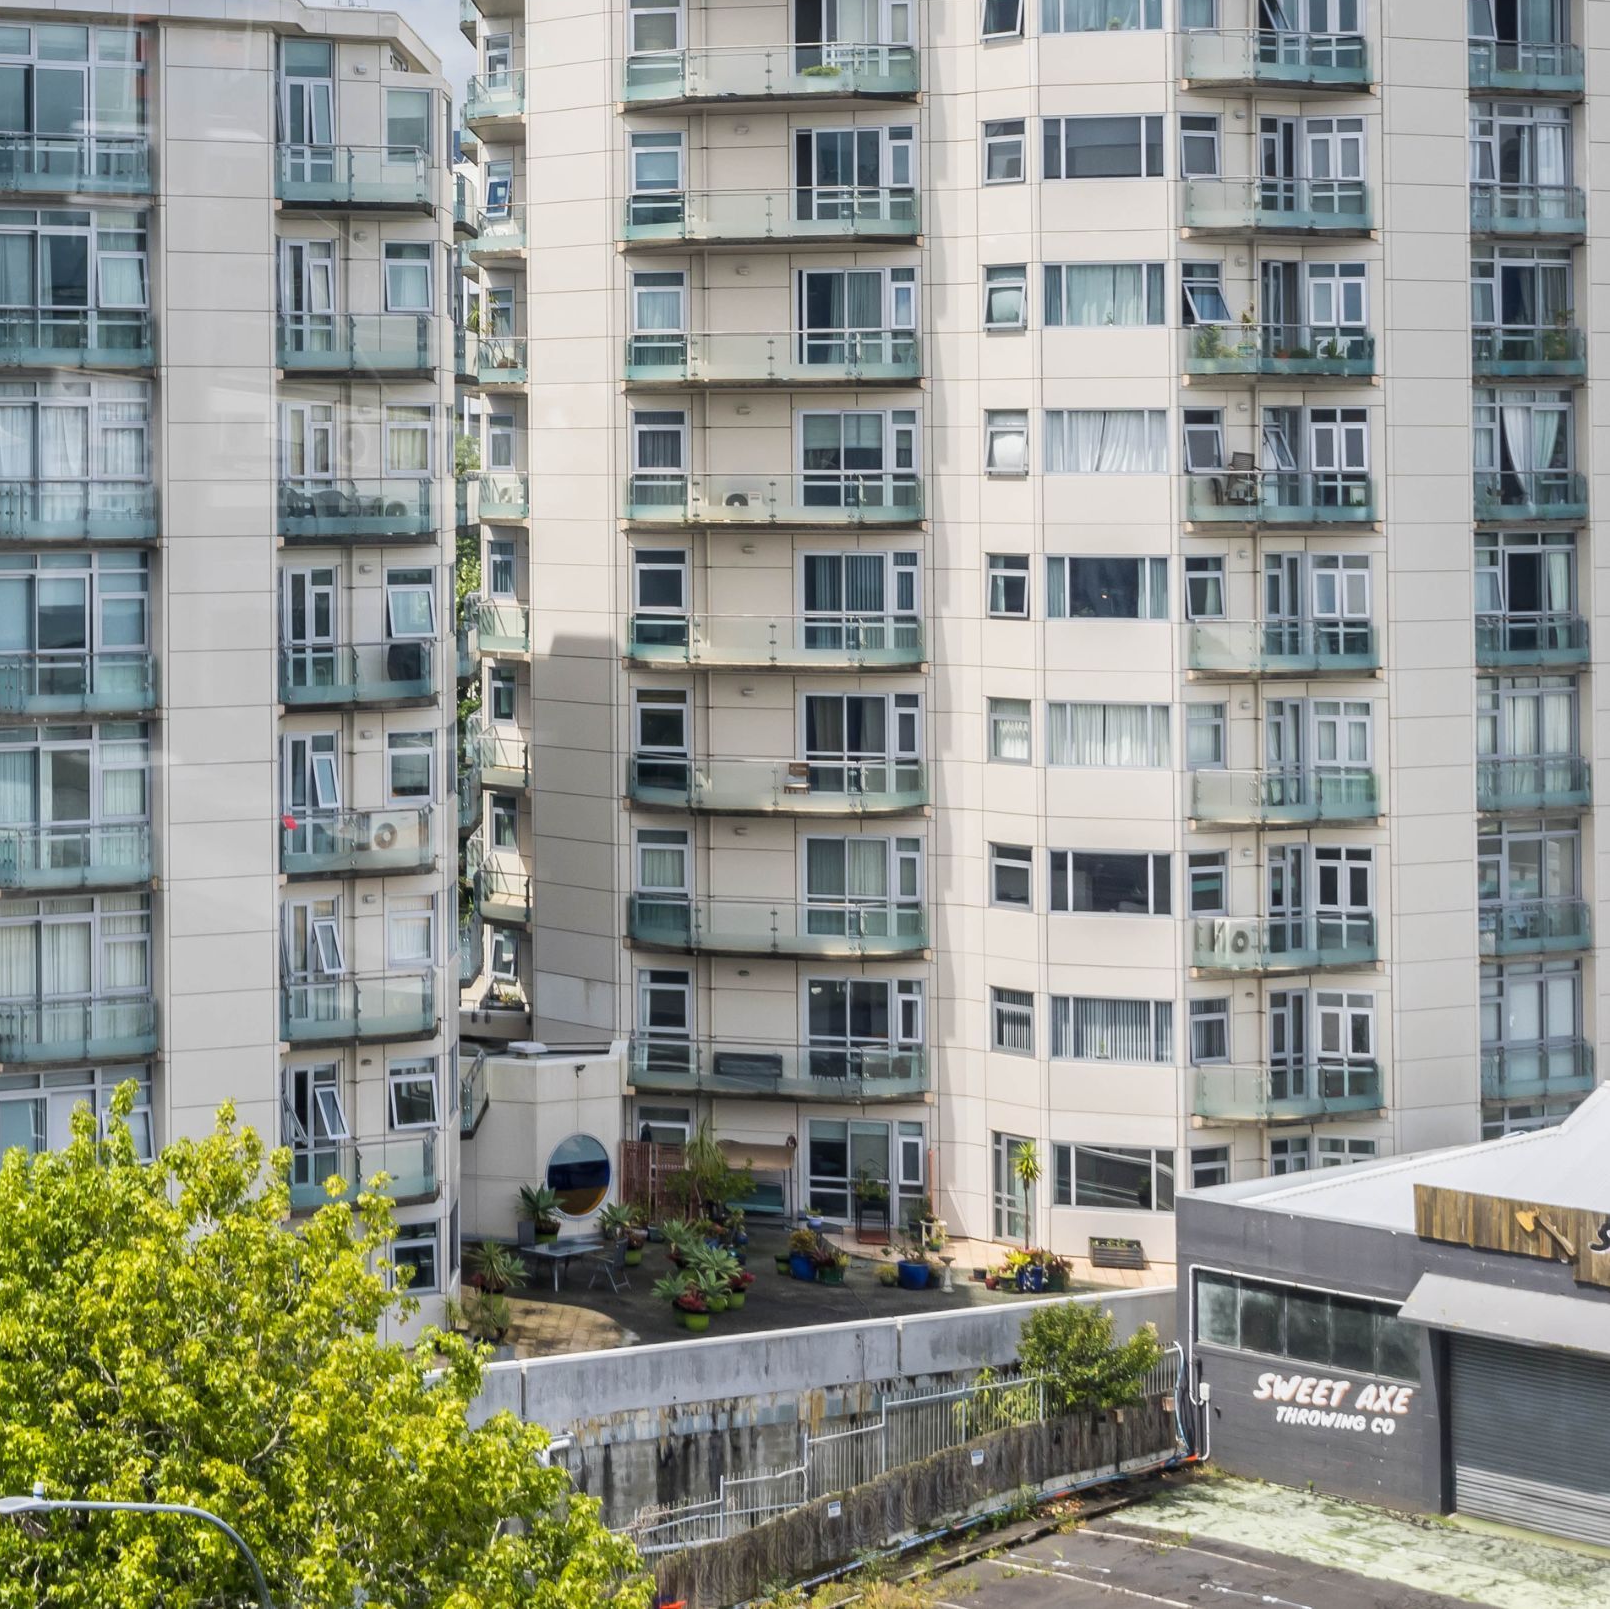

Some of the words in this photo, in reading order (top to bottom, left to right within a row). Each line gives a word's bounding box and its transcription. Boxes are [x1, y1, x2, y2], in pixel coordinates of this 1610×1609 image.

[1252, 1372, 1351, 1408] SWEET
[1354, 1383, 1414, 1415] AXE
[1276, 1405, 1367, 1432] THROWING
[1370, 1417, 1397, 1436] CO
